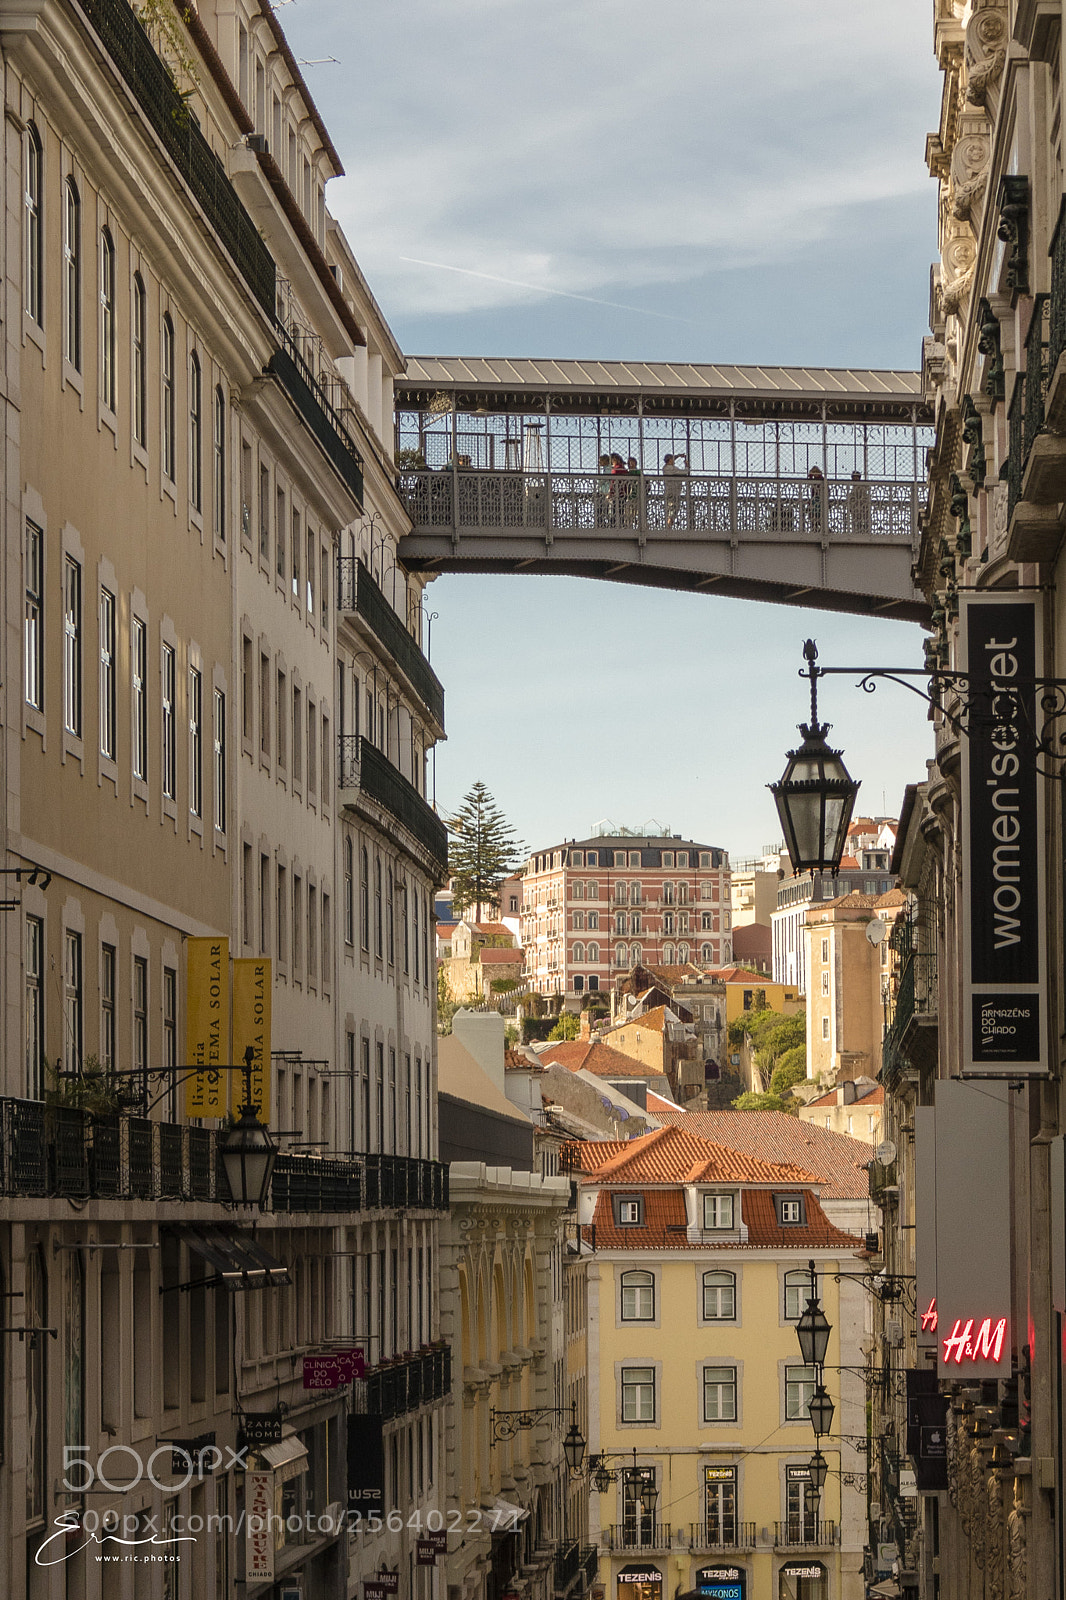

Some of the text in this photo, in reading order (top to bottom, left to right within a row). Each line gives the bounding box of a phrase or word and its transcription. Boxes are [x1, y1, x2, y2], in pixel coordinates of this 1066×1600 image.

[209, 944, 221, 1009] SOLAR
[254, 965, 264, 1025] SOLAR
[981, 1018, 996, 1026] DO
[981, 1026, 1017, 1034] CHIADO
[192, 1042, 205, 1106] livrria
[943, 1318, 1007, 1363] H&M
[313, 1370, 327, 1378] DO
[418, 1547, 434, 1555] MUJI
[702, 1568, 739, 1578] TEZENIS
[785, 1566, 821, 1576] TEZENIS
[380, 1574, 397, 1582] MUJI
[618, 1571, 662, 1582] TEZENIS
[366, 1590, 384, 1599] MUJI
